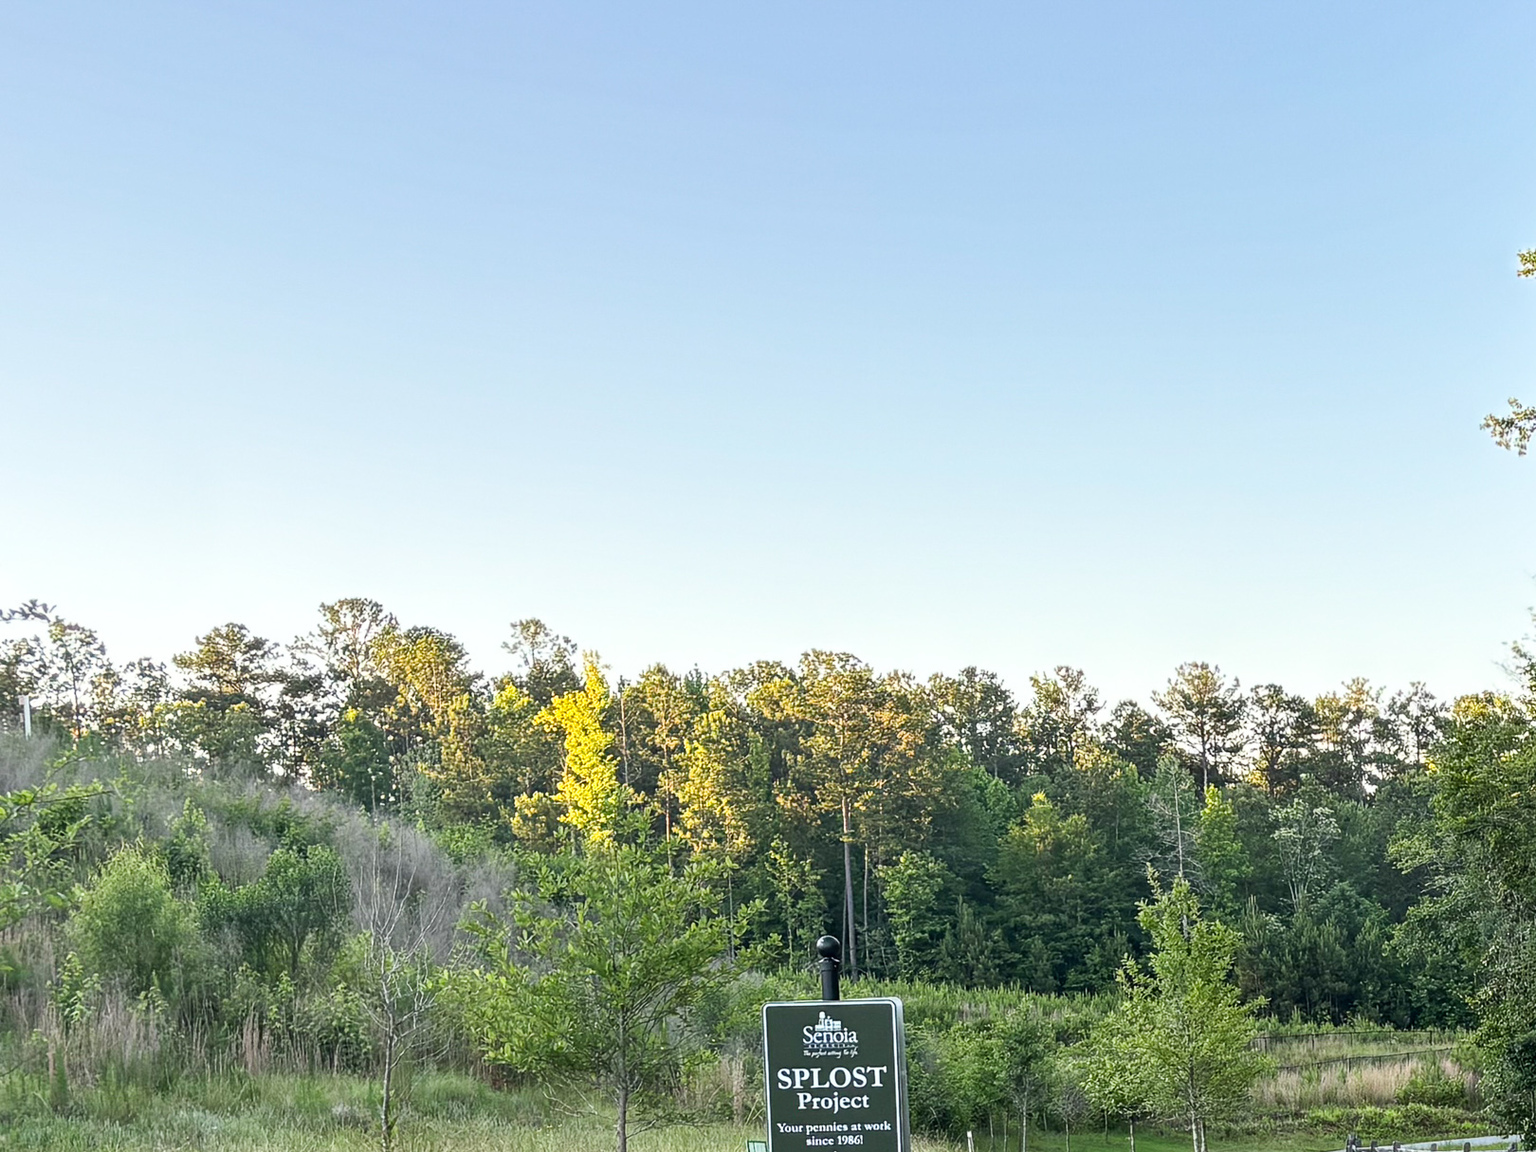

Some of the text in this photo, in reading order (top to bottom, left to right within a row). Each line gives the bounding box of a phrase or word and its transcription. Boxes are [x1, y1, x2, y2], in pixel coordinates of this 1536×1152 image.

[802, 1025, 858, 1044] Senoia
[777, 1065, 888, 1090] SPLOST
[796, 1091, 870, 1114] Project
[776, 1120, 892, 1135] Your pennies at work
[805, 1134, 864, 1146] since 1986!
